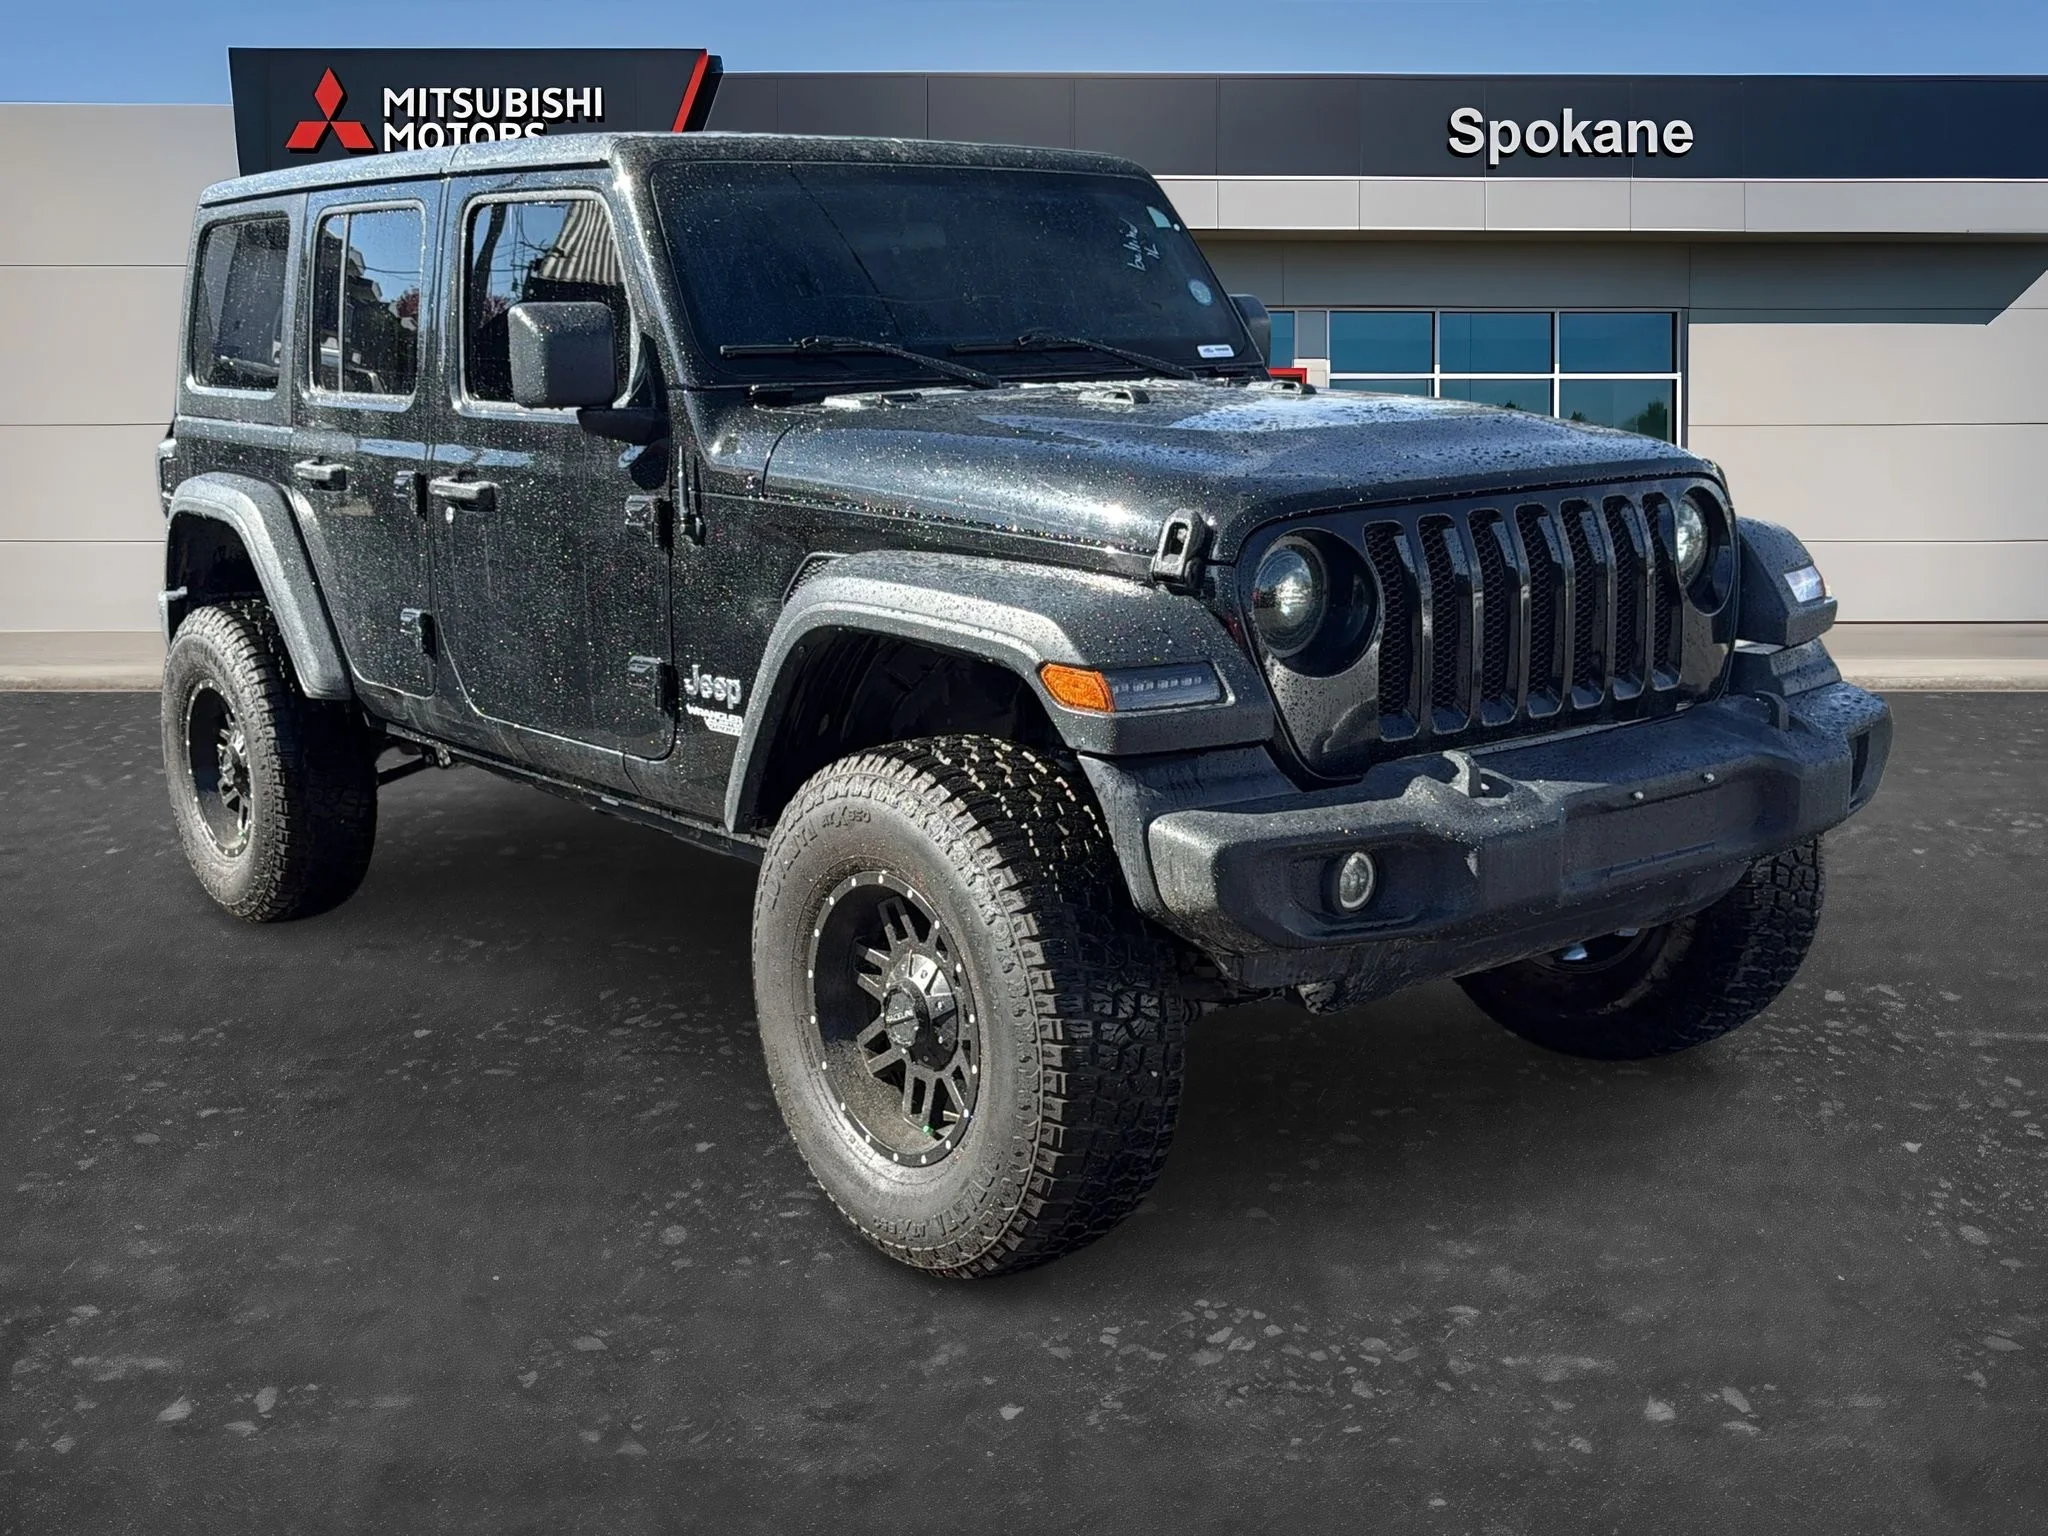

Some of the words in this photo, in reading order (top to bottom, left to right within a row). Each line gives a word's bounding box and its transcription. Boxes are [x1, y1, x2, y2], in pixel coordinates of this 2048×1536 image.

[383, 87, 602, 118] MITSUBISHI
[1448, 107, 1694, 165] Spokane
[683, 664, 742, 710] Jeep
